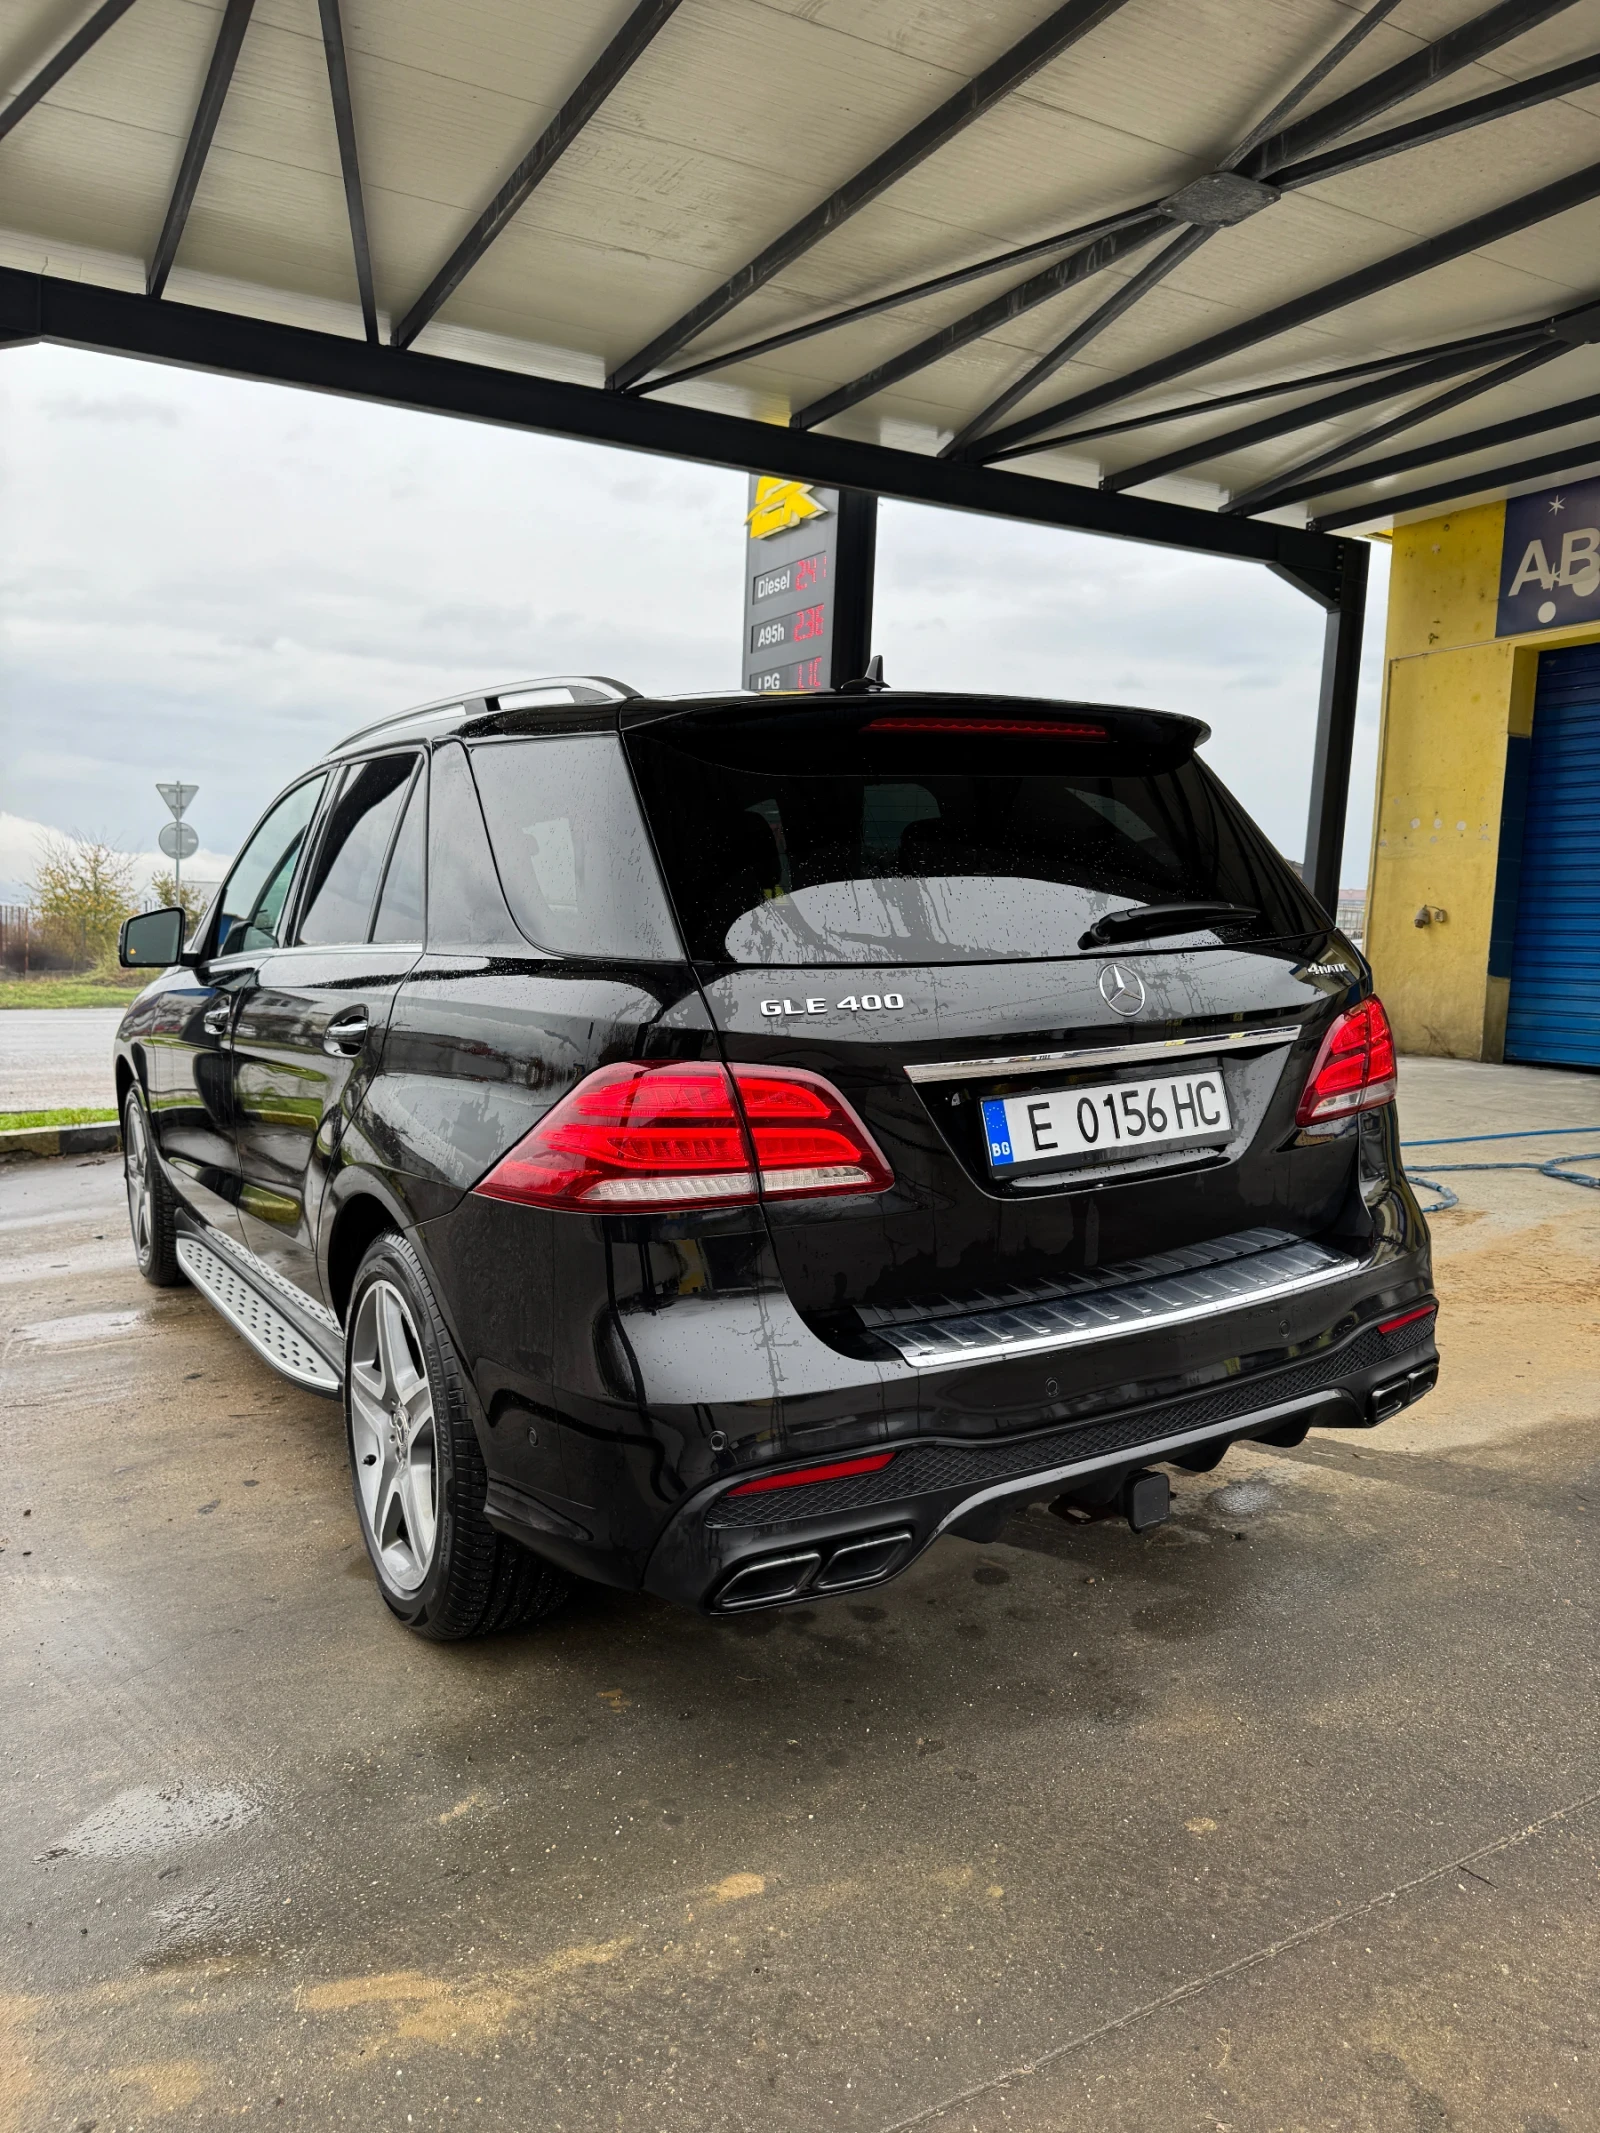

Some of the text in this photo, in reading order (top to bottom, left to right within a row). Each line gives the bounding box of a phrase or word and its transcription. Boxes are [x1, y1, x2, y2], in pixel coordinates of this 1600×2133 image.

[757, 570, 791, 599] Diesel
[757, 624, 785, 648] A95h
[760, 993, 905, 1017] GLE 400
[1027, 1080, 1221, 1151] E 0156 HC
[991, 1142, 1011, 1157] BG
